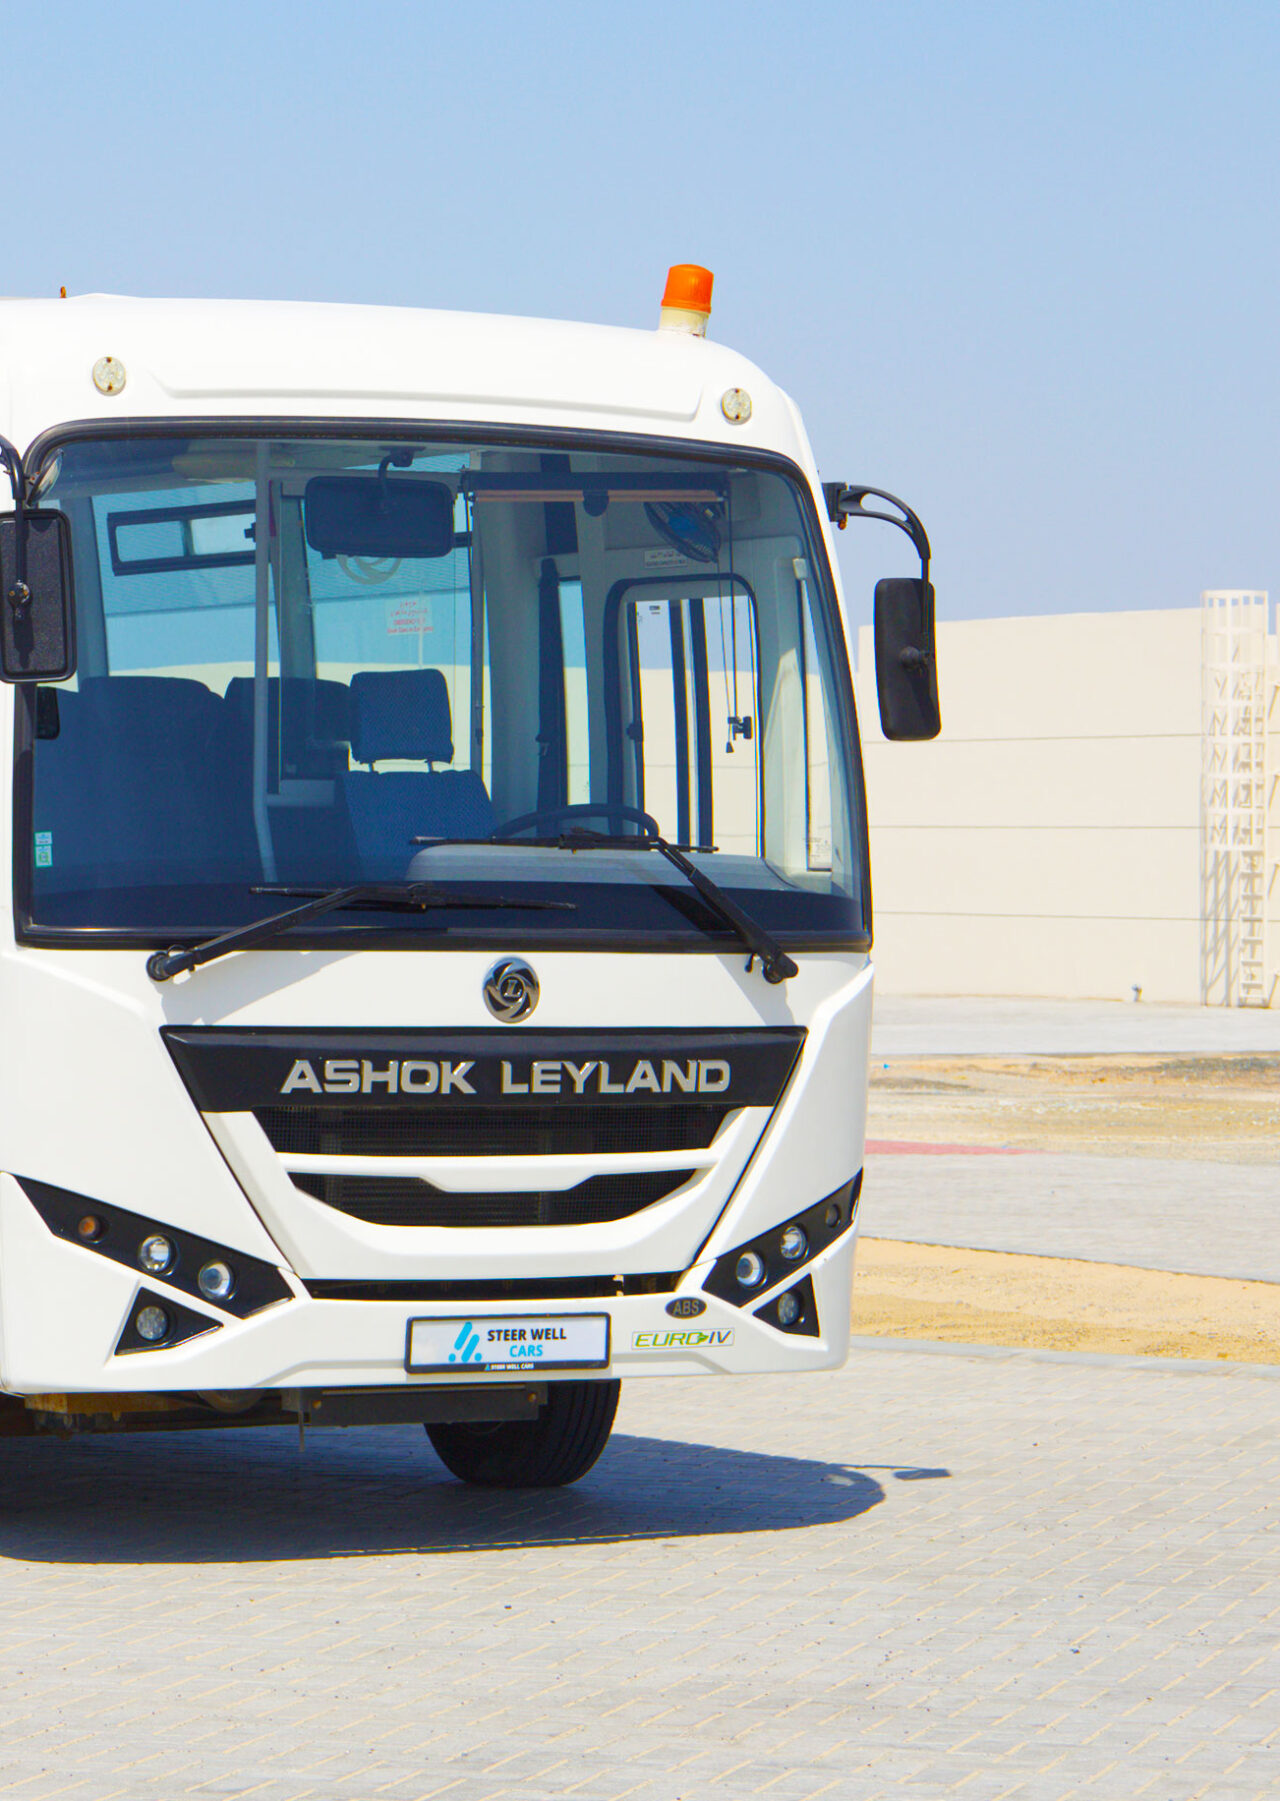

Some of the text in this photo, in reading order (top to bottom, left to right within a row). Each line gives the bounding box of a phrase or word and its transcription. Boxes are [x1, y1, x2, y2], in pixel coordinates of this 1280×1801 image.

[280, 1058, 731, 1095] ASHOK LEYLAND
[673, 1300, 700, 1316] ABS
[487, 1328, 567, 1342] STEER WELL
[509, 1344, 544, 1358] CARS
